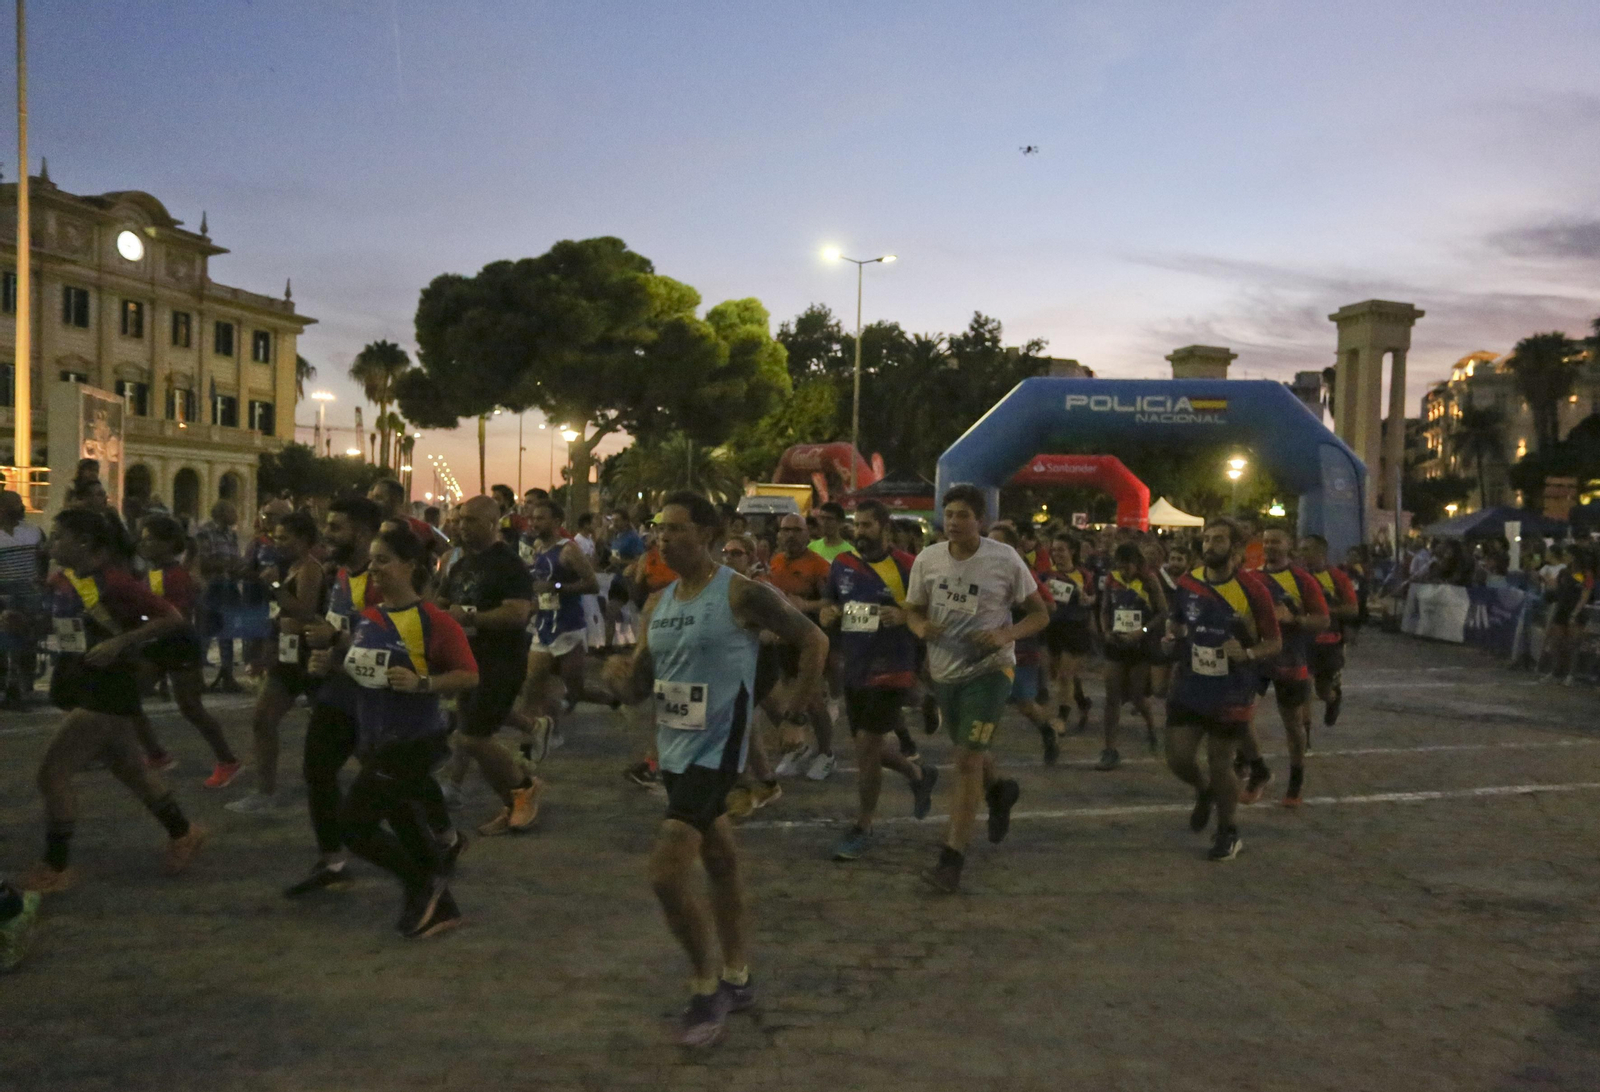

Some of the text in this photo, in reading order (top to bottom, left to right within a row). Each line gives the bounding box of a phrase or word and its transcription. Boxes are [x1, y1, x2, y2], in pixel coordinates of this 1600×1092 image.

[1135, 413, 1227, 424] NACIONAL
[1046, 462, 1098, 474] Santander
[946, 591, 968, 604] 785
[651, 615, 695, 631] nerja
[355, 666, 376, 678] 522
[665, 703, 689, 717] 445
